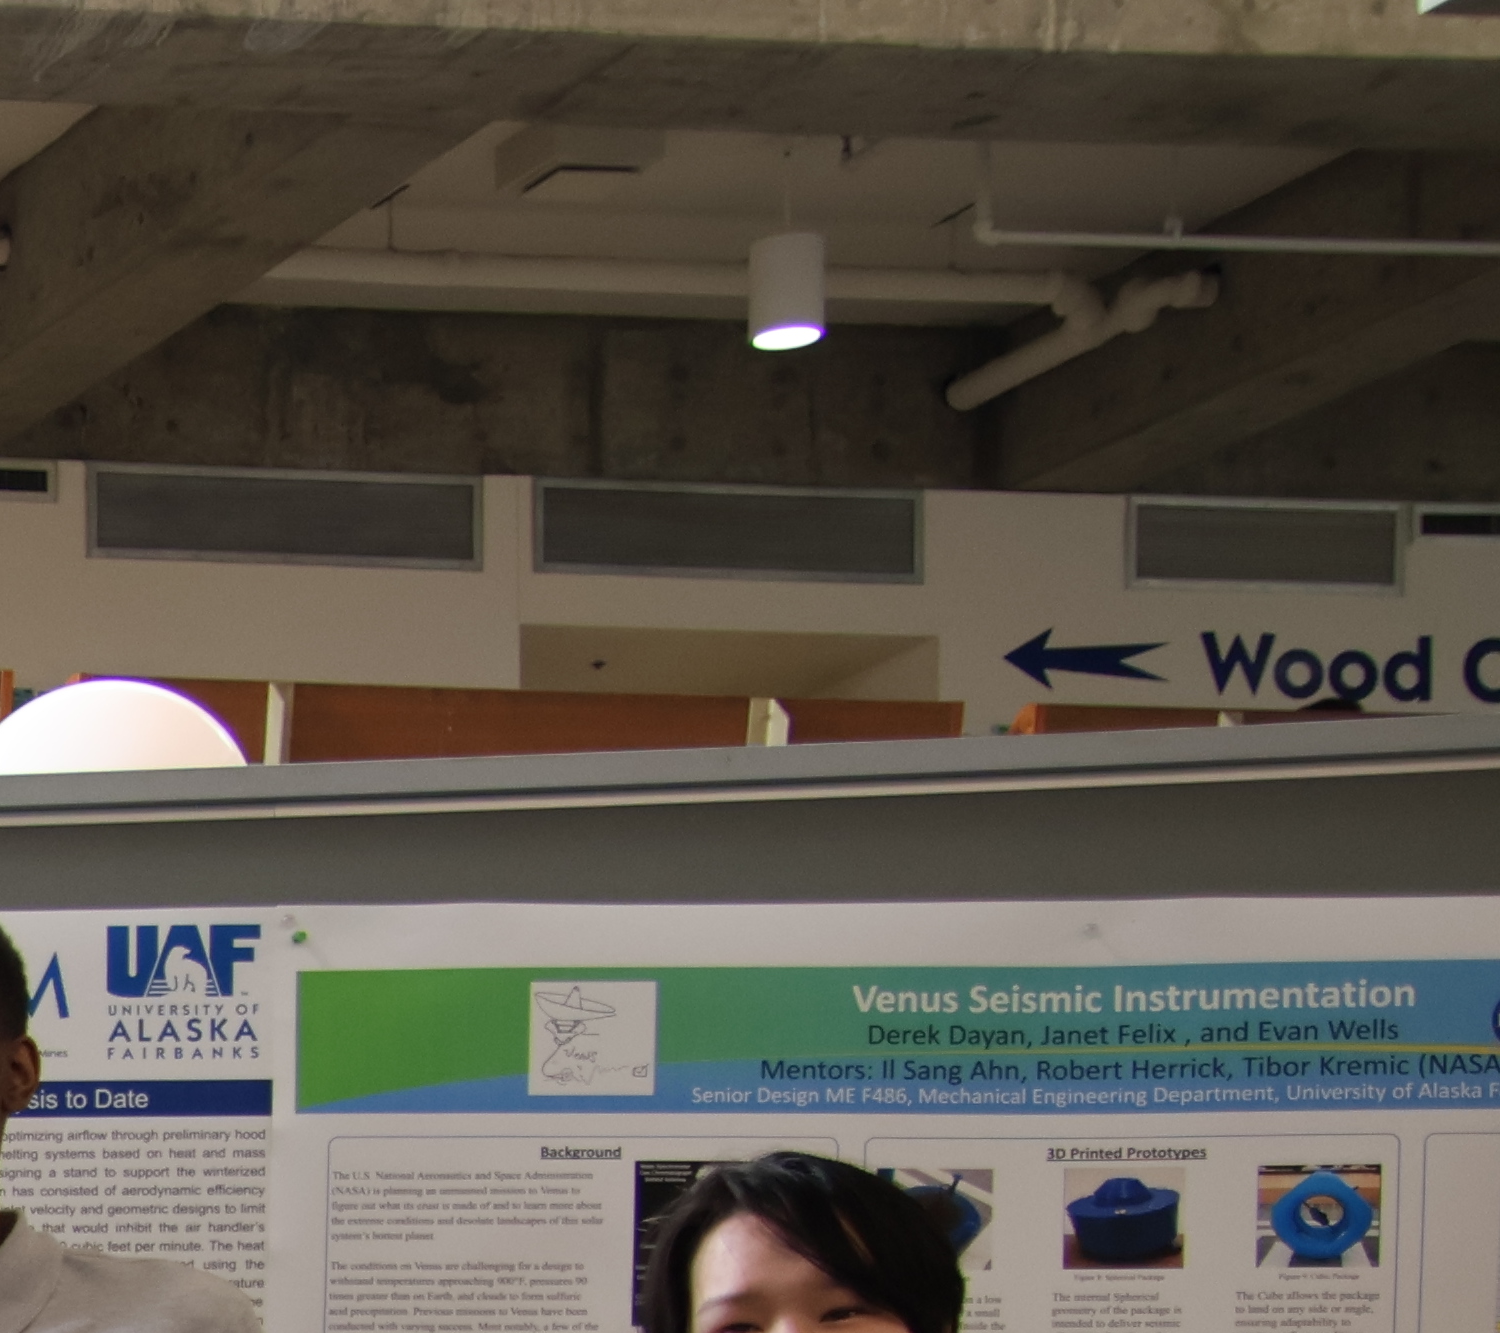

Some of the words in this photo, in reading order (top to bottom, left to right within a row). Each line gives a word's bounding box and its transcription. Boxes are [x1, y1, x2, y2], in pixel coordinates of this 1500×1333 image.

[1201, 632, 1431, 701] Wood
[106, 924, 261, 998] UAF
[853, 985, 958, 1013] Venus
[972, 985, 1101, 1013] Seismic
[1114, 979, 1414, 1012] Instrumentation
[108, 1005, 223, 1016] UNIVERSITY
[237, 1003, 259, 1015] OF
[109, 1020, 257, 1042] ALASKA
[869, 1024, 940, 1045] Derek
[950, 1025, 1032, 1049] Dayan,
[1041, 1021, 1109, 1045] Janet
[1119, 1023, 1175, 1044] Felix
[1201, 1021, 1249, 1042] and
[1259, 1021, 1318, 1041] Evan
[1328, 1019, 1398, 1040] Wells
[107, 1048, 259, 1059] FAIRBANKS
[759, 1056, 872, 1080] Mentors:
[904, 1060, 961, 1085] Sang
[970, 1059, 1027, 1084] Ahn,
[1037, 1059, 1121, 1080] Robert
[1132, 1057, 1232, 1081] Herrick,
[1243, 1056, 1310, 1077] Tibor
[1320, 1055, 1409, 1076] Kremic
[1419, 1054, 1500, 1078] (NASA
[67, 1090, 87, 1109] to
[95, 1089, 148, 1108] Date
[692, 1087, 752, 1103] Senior
[758, 1087, 819, 1106] Design
[827, 1087, 855, 1103] ME
[862, 1087, 912, 1106] F486,
[919, 1087, 1025, 1104] Mechanical
[1033, 1088, 1147, 1107] Engineering
[1154, 1087, 1279, 1105] Department,
[1287, 1084, 1386, 1102] University
[1394, 1082, 1411, 1099] of
[1418, 1082, 1481, 1098] Alaska
[67, 1130, 107, 1141] airflow
[111, 1130, 158, 1142] through
[163, 1129, 231, 1142] preliminary
[235, 1129, 266, 1140] hood
[541, 1146, 621, 1160] Background
[1047, 1146, 1065, 1162] 3D
[1070, 1146, 1122, 1162] Printed
[1126, 1145, 1207, 1163] Prototypes
